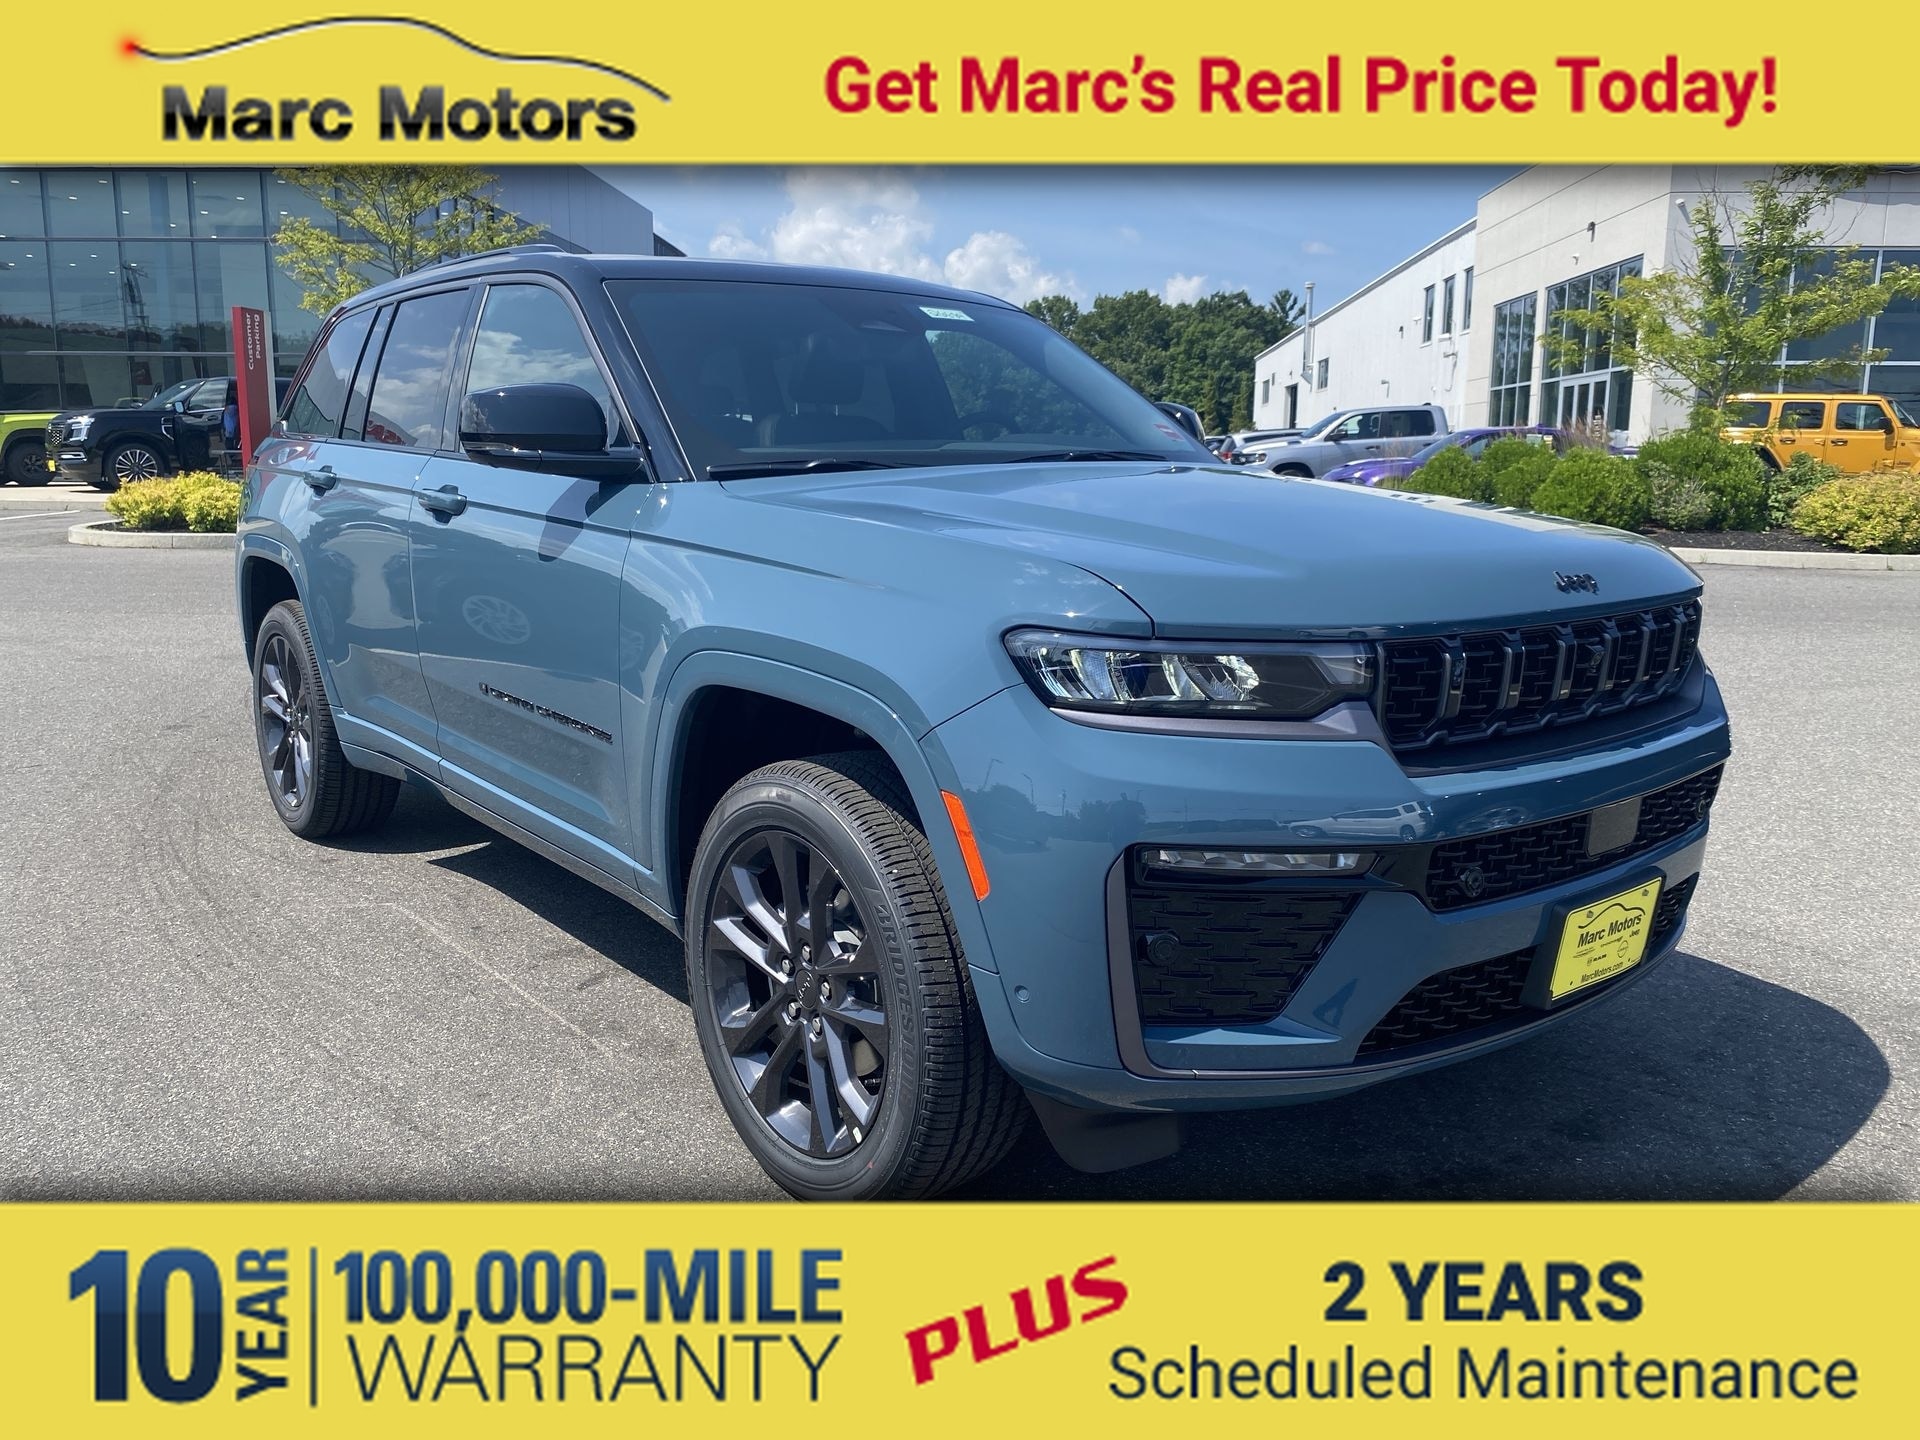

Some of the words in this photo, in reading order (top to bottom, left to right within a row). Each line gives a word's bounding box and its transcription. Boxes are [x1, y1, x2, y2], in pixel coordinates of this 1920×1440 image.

[246, 312, 254, 370] Customer
[1554, 571, 1599, 595] Jeep
[1577, 928, 1606, 948] Marc
[1607, 914, 1642, 937] Motors
